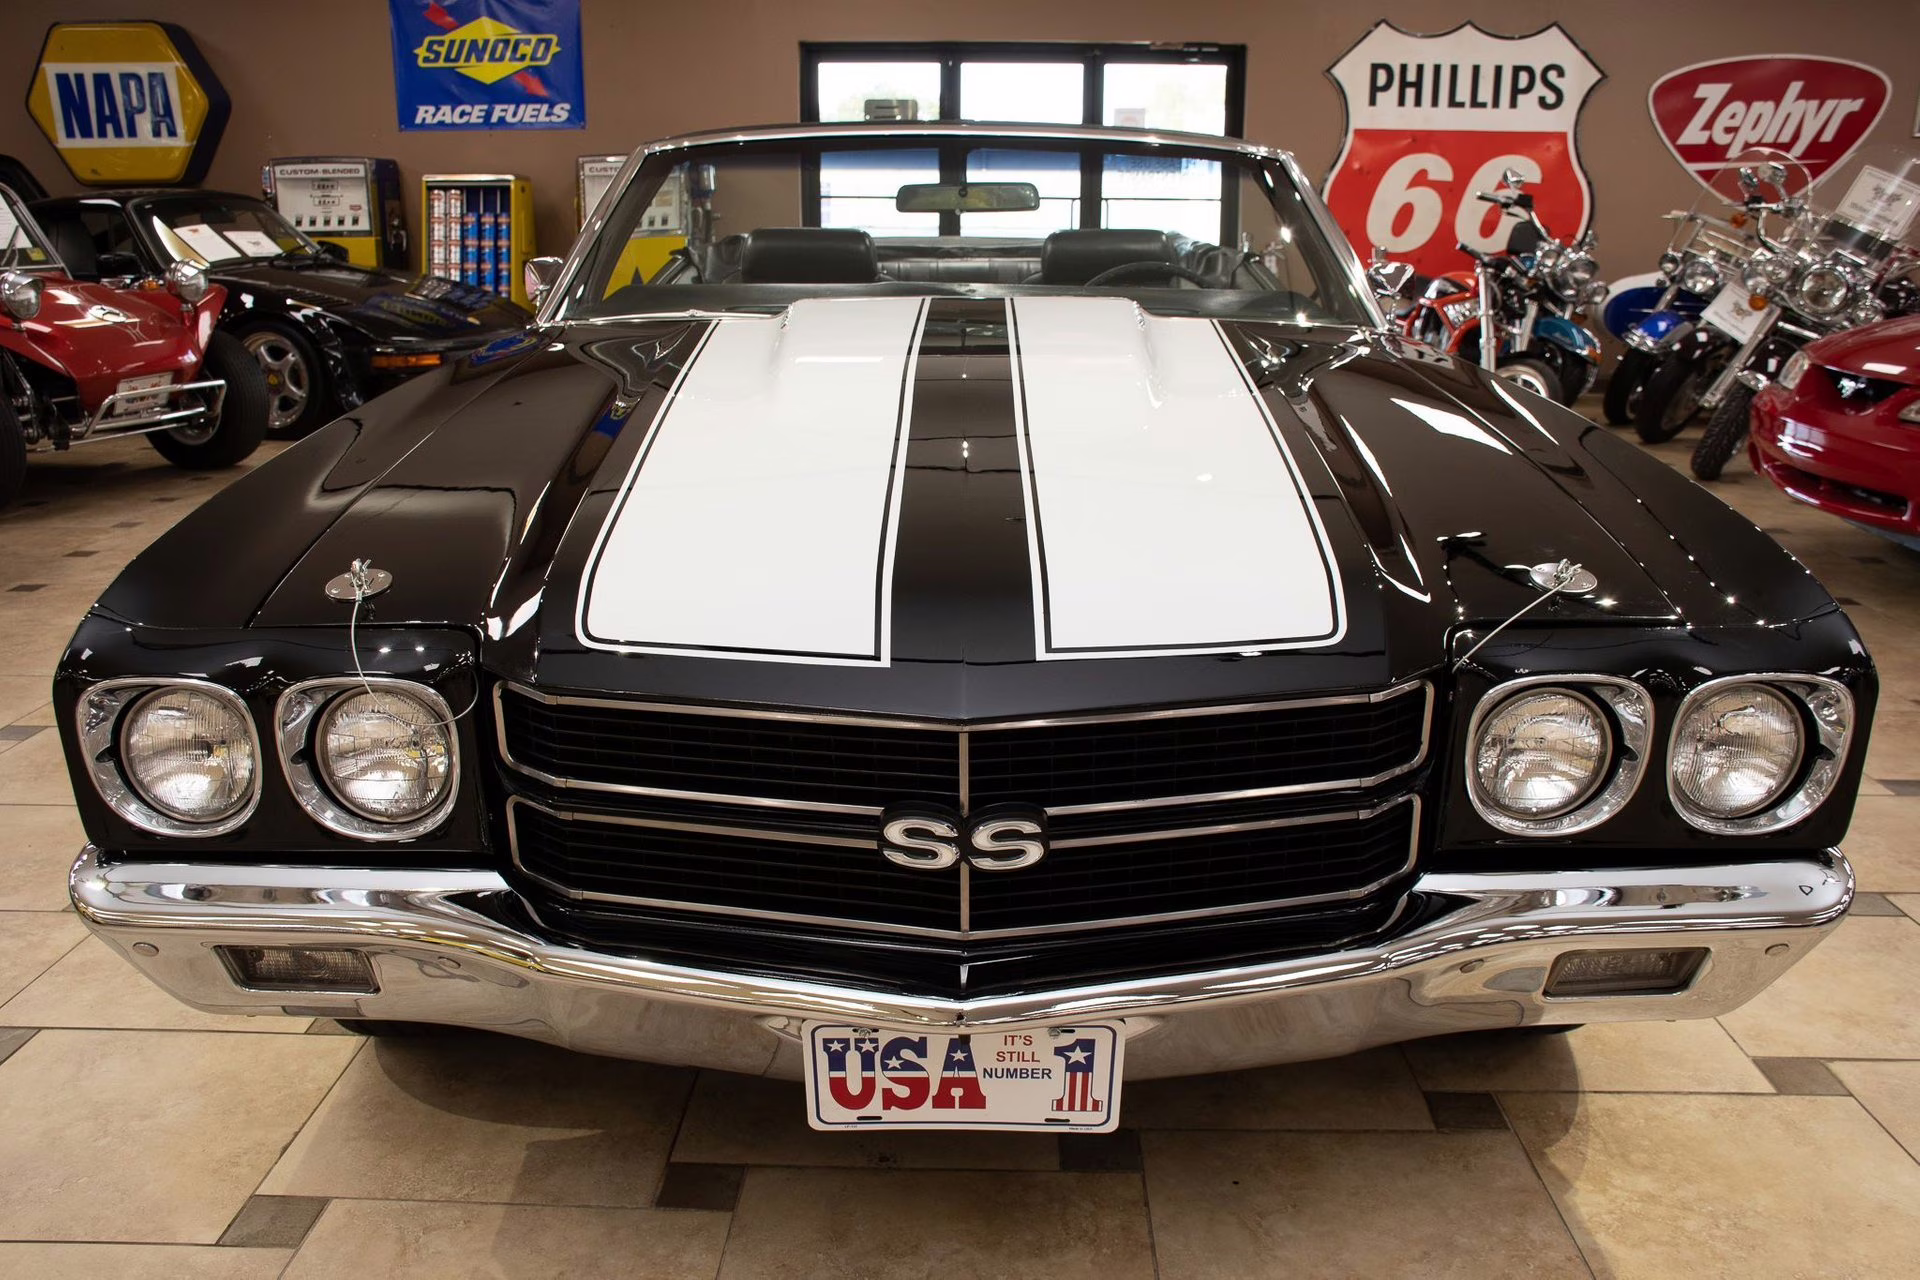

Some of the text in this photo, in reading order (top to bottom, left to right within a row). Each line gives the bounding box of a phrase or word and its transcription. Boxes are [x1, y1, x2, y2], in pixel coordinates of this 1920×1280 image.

[422, 37, 552, 64] SUNOCO
[55, 72, 178, 139] NAPA
[1368, 62, 1565, 110] PHILLIPS
[414, 103, 571, 124] RACE FUELS
[1675, 80, 1865, 159] Zephyr
[1366, 152, 1542, 255] 66
[882, 818, 1045, 871] SS
[996, 1051, 1041, 1063] STILL
[1004, 1034, 1033, 1046] IT'S
[822, 1037, 987, 1111] USA
[983, 1067, 1052, 1080] NUMBER
[1052, 1038, 1103, 1112] 1
